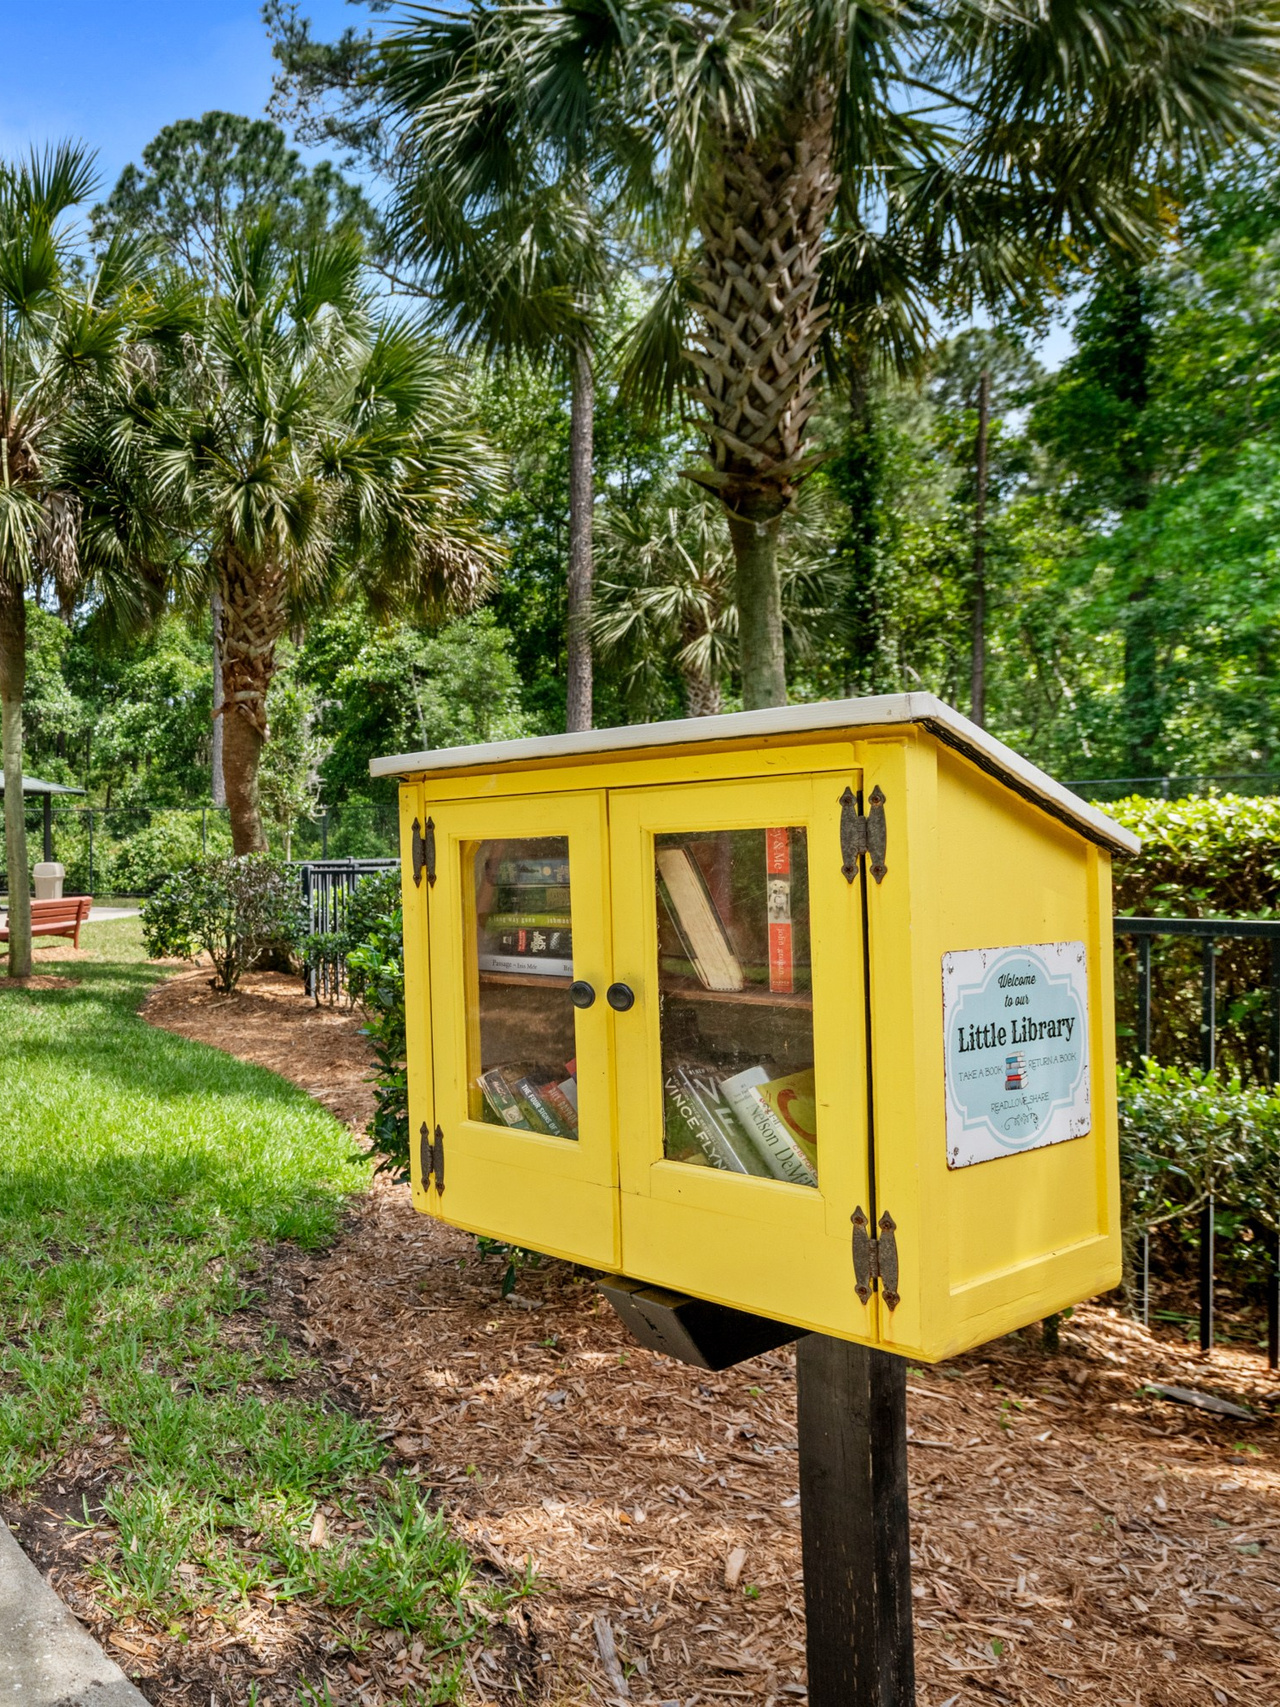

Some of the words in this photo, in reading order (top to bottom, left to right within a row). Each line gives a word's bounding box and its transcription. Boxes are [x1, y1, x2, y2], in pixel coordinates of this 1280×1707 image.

[773, 841, 784, 850] &
[773, 853, 785, 870] Me
[776, 928, 785, 946] john
[492, 959, 512, 969] Passage
[997, 973, 1036, 988] Welcome
[1004, 995, 1013, 1007] to
[1015, 994, 1030, 1006] our
[958, 1022, 1007, 1053] Little
[1010, 1016, 1075, 1044] Library
[1028, 1057, 1053, 1071] RETURN
[1053, 1056, 1059, 1064] A
[1060, 1052, 1077, 1063] BOOK
[959, 1069, 978, 1081] TAKE
[978, 1070, 984, 1078] A
[985, 1066, 1004, 1077] BOOK
[521, 1084, 532, 1097] THE
[528, 1094, 541, 1109] FOUR
[538, 1107, 552, 1124] SIGNS
[664, 1077, 701, 1130] VINCE
[747, 1103, 779, 1147] Nelson
